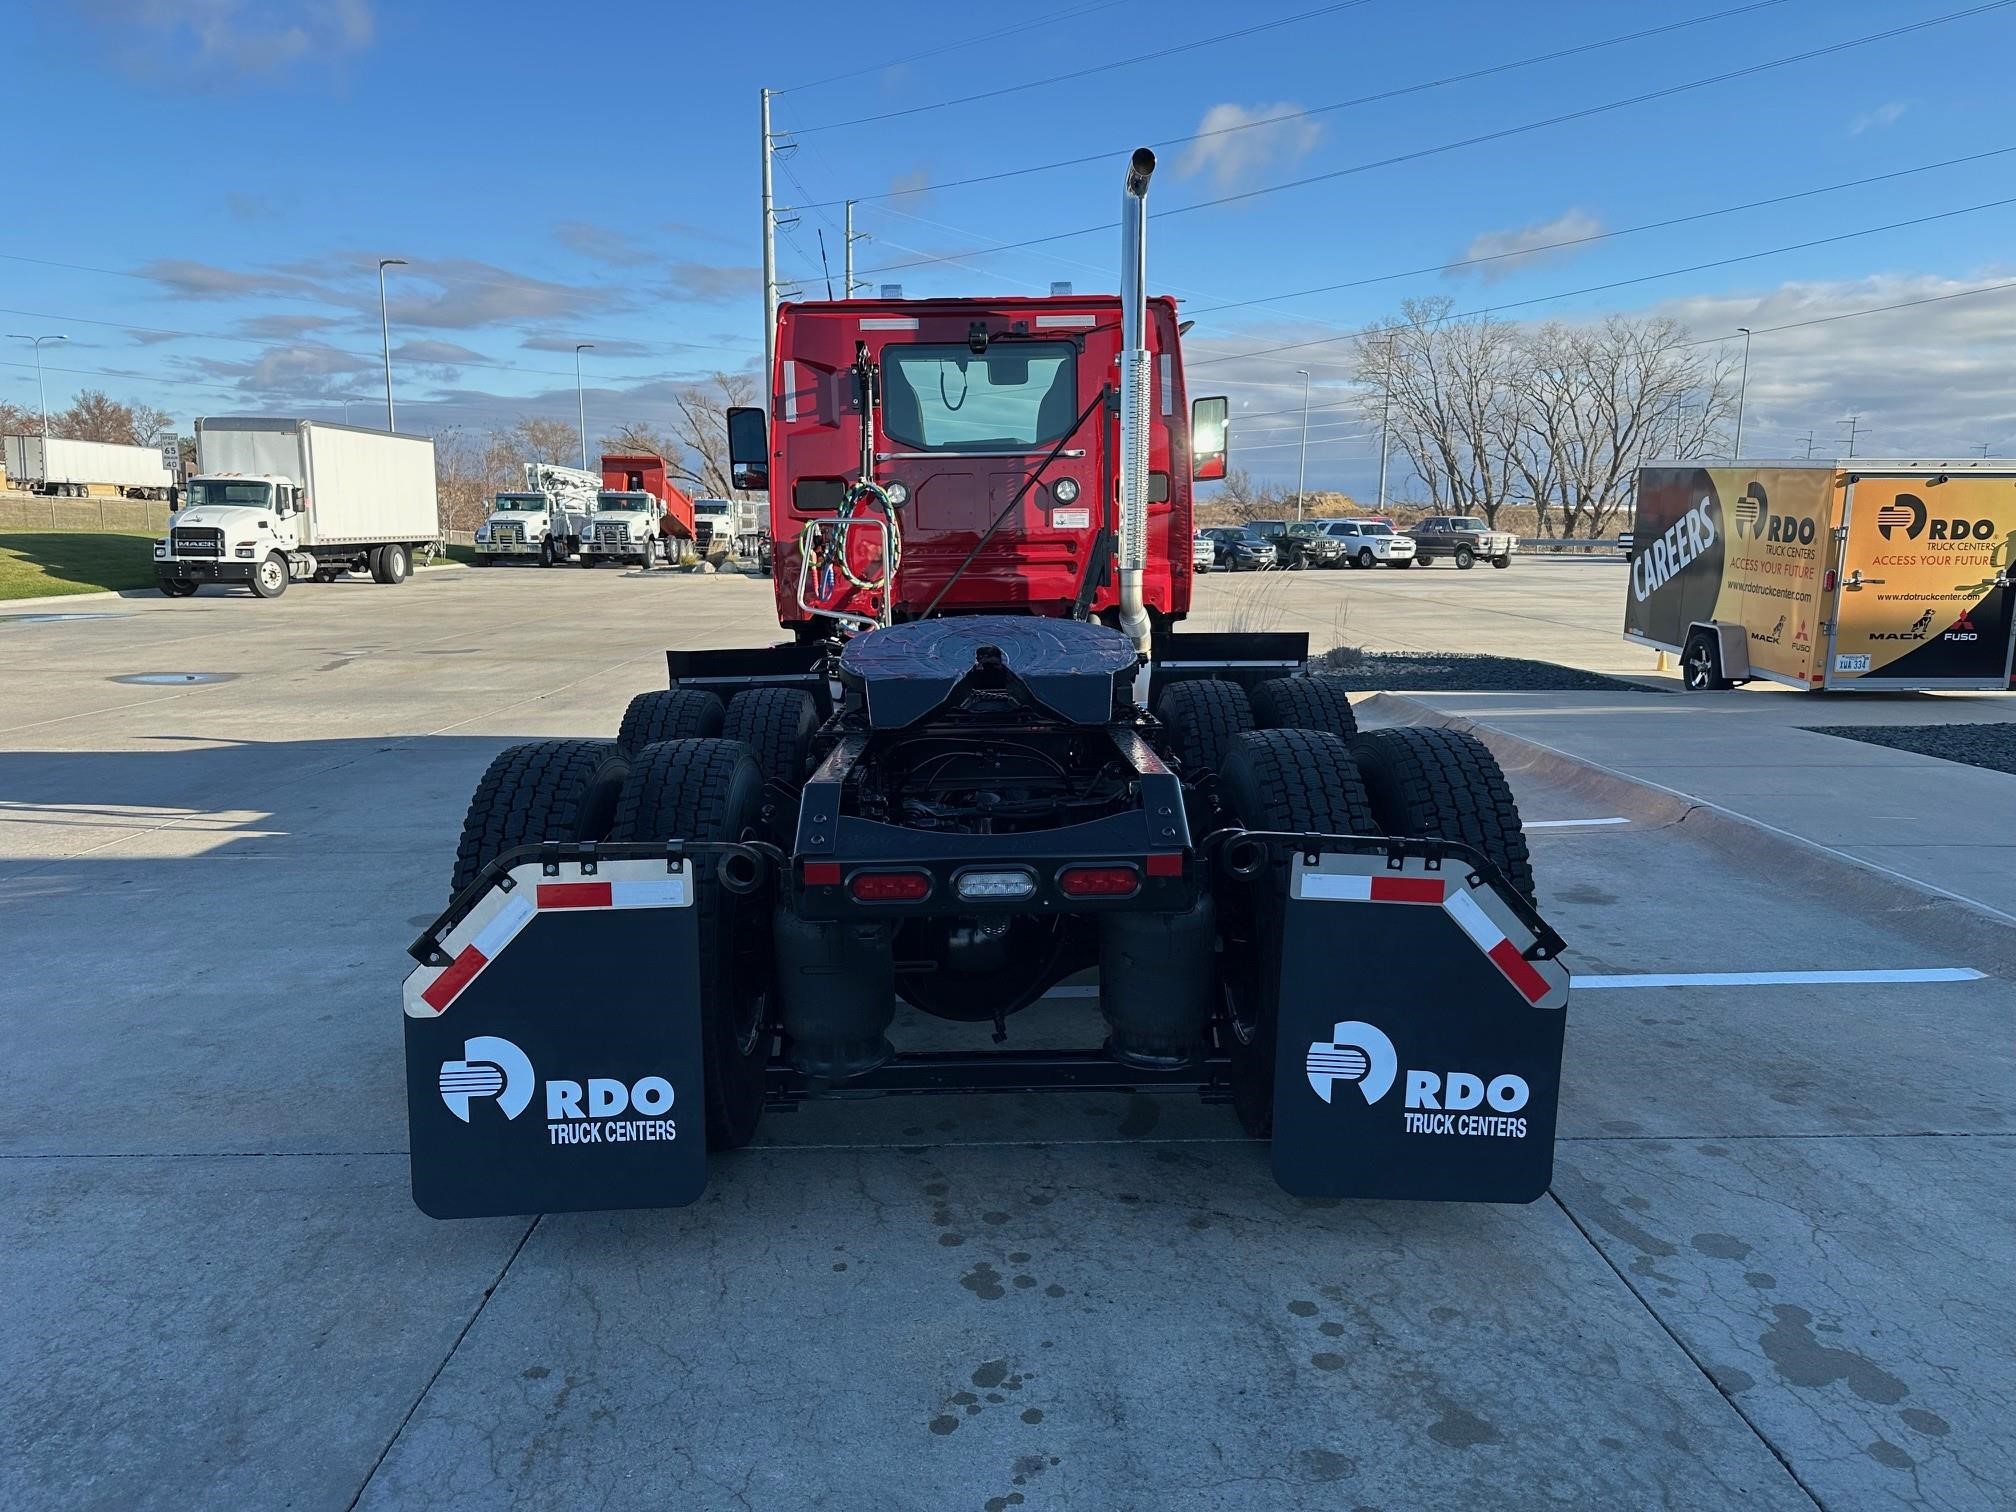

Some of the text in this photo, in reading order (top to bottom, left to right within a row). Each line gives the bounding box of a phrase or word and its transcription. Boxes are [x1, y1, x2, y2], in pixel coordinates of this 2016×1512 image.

[164, 447, 176, 455] 65
[1767, 515, 1815, 545] RDO
[1929, 519, 1995, 541] RDO
[1633, 496, 1715, 602] CAREERS
[1766, 544, 1815, 560] TRUCK CENTERS
[1927, 542, 1996, 551] TRUCK CENTERS
[1730, 557, 1814, 579] ACCESS YOUR FUTURE
[1872, 555, 1997, 566] ACCESS YOUR FUTURE
[1727, 581, 1812, 603] www.rdotruckcenter.com
[1877, 593, 1980, 601] www.rdotruckcenter.com
[1751, 632, 1780, 645] MACK
[1791, 642, 1811, 652] FUSO
[1944, 633, 1978, 641] FUSO
[546, 1076, 676, 1120] RDO
[1404, 1070, 1530, 1113] RDO
[547, 1120, 677, 1145] TRUCK CENTERS
[1404, 1112, 1528, 1138] TRUCK CENTERS
